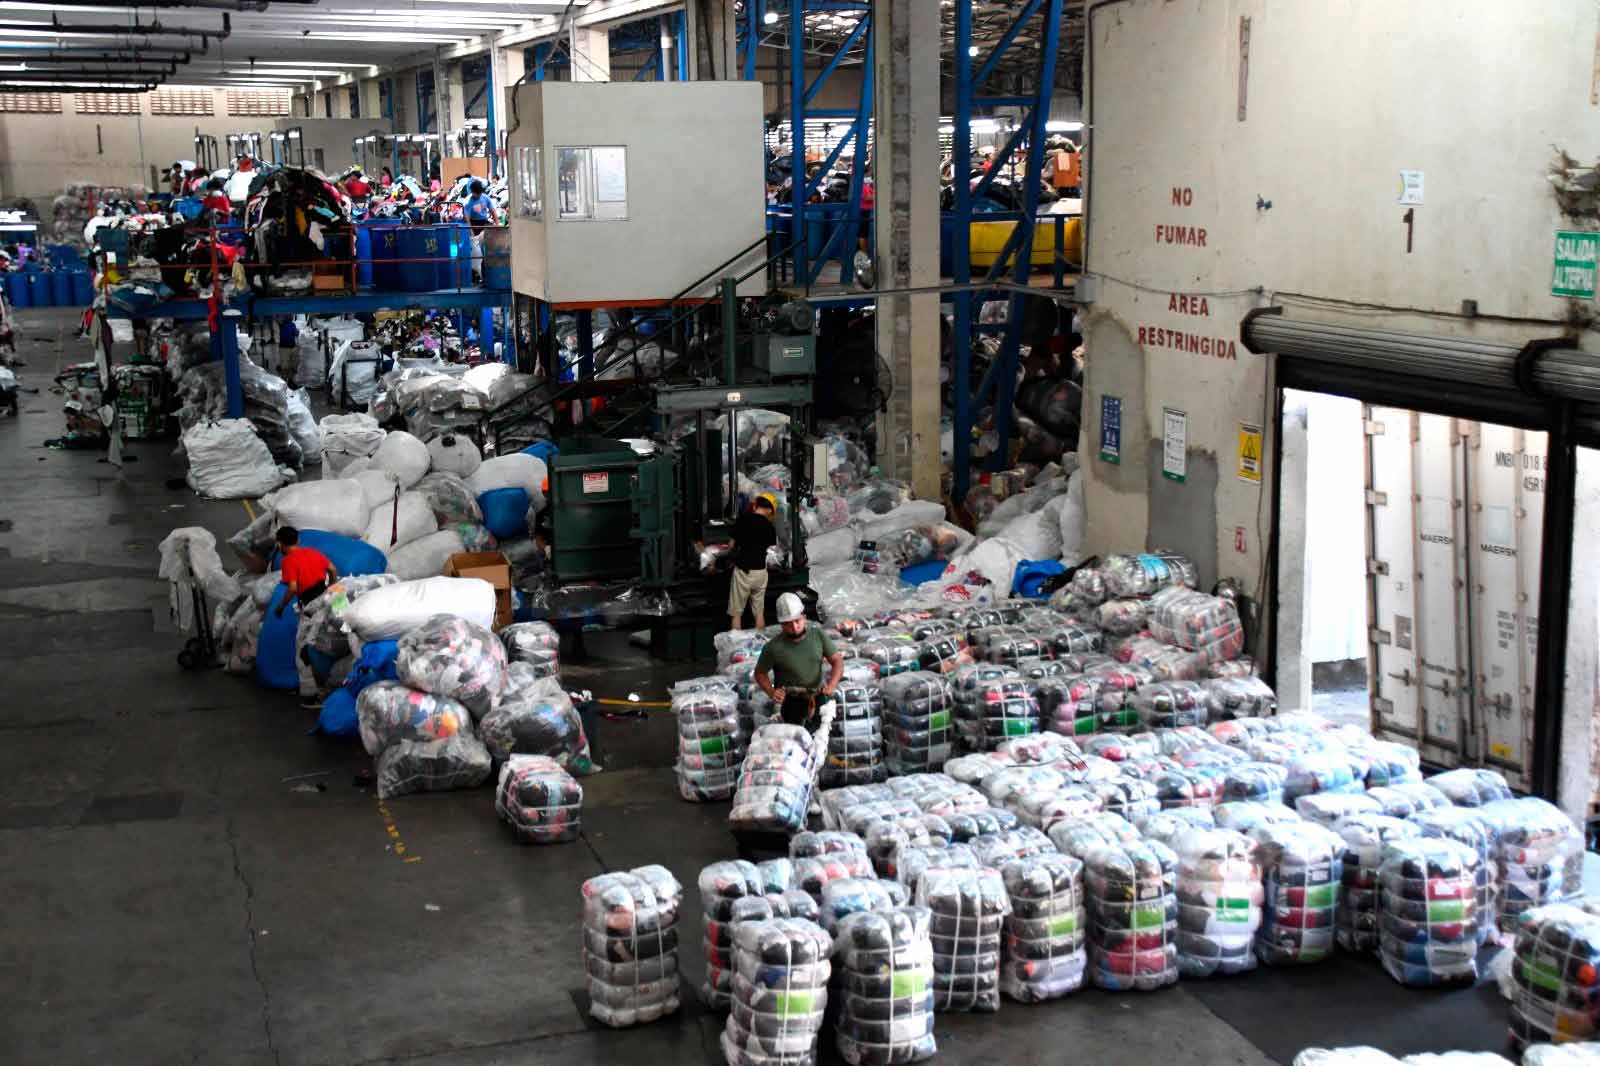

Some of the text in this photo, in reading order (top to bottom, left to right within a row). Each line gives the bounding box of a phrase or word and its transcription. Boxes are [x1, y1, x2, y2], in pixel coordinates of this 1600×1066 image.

[1172, 187, 1193, 207] NO
[1156, 225, 1208, 247] FUMAR
[1403, 208, 1413, 254] 1
[1556, 237, 1595, 261] SALIDA
[1168, 292, 1209, 317] AREA
[1138, 326, 1237, 361] RESTRINGIDA
